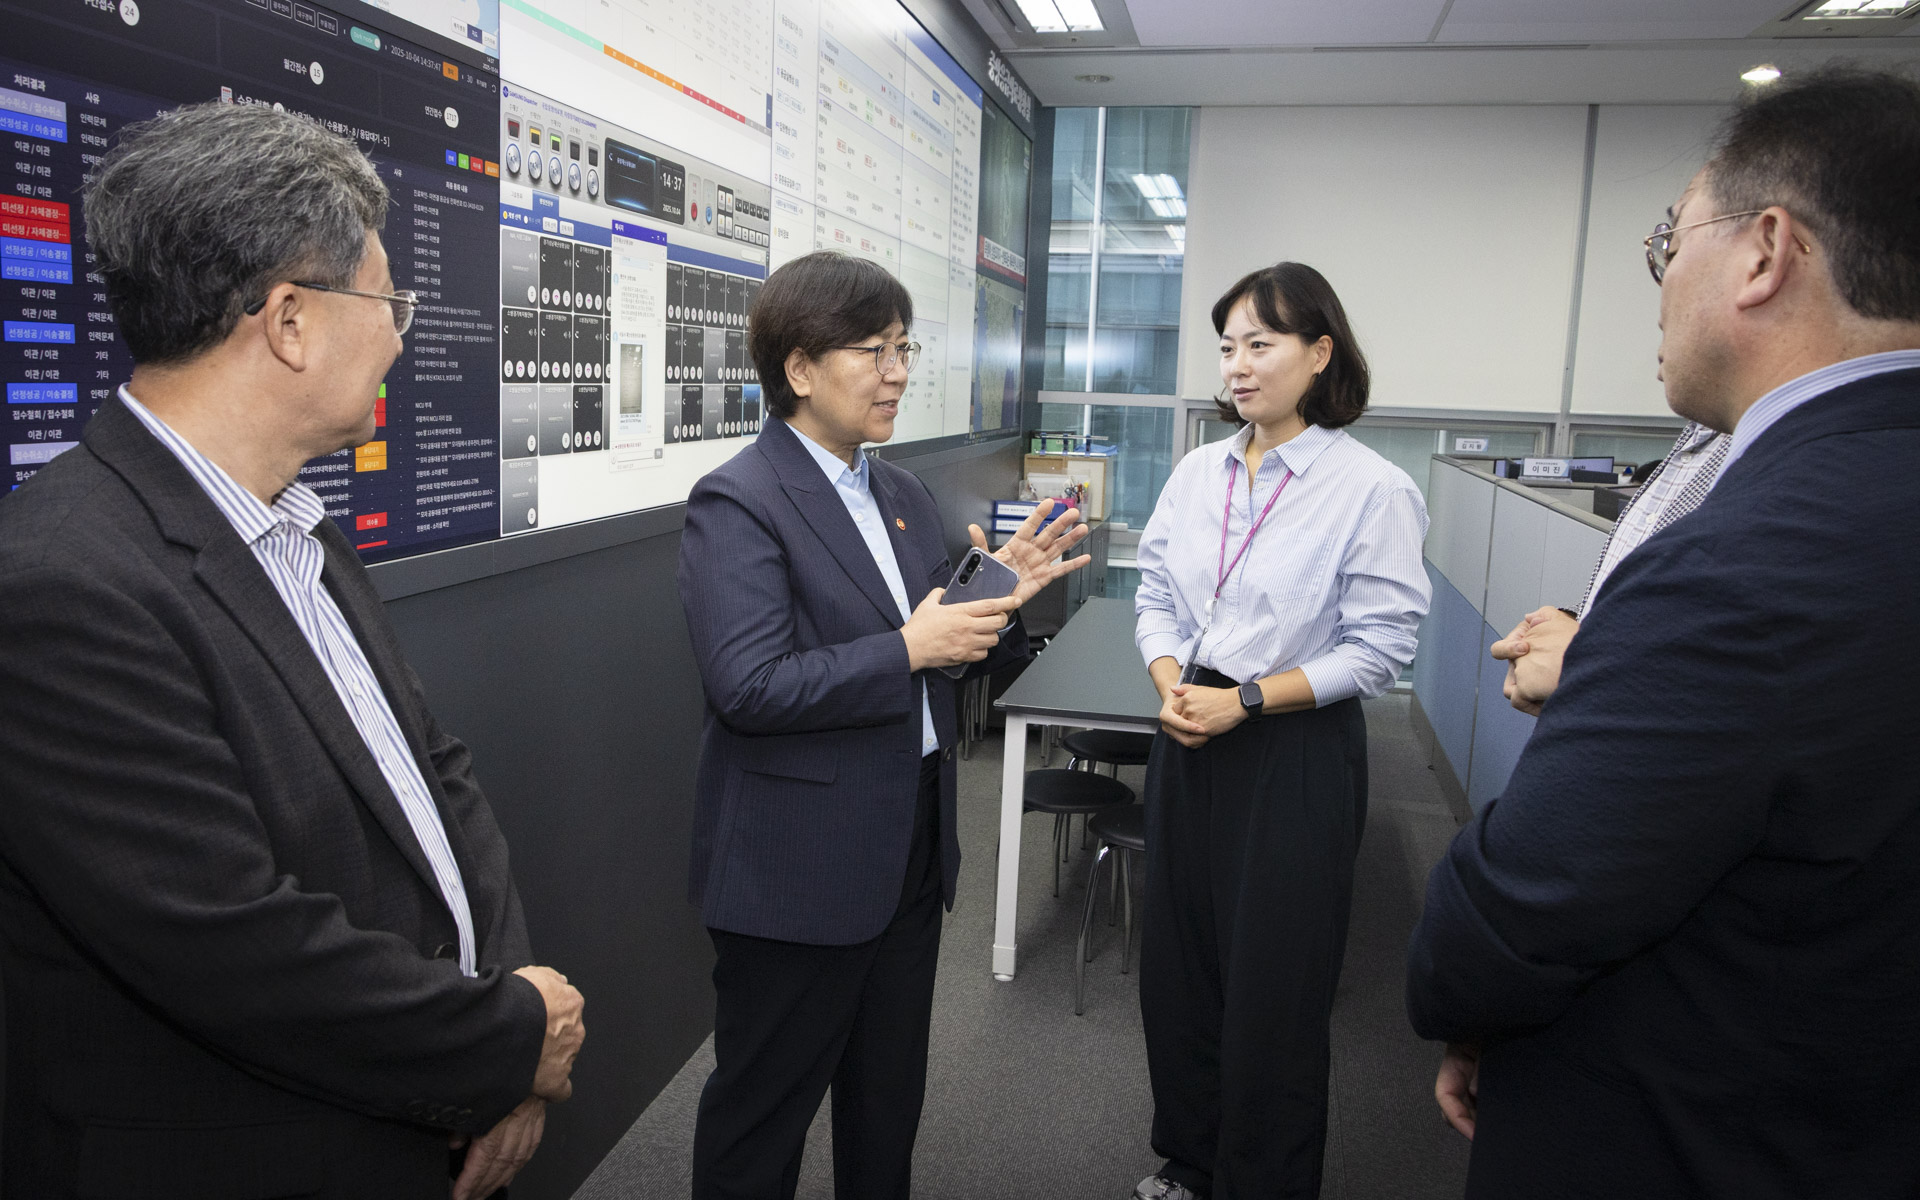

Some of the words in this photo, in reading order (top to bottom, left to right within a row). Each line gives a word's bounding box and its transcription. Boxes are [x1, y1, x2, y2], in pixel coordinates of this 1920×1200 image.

[85, 0, 116, 13] 간접수
[391, 45, 420, 64] 2025-10-04
[420, 57, 441, 72] 14:37:47
[283, 58, 308, 75] 월간접수
[14, 74, 46, 92] 처리결과
[85, 92, 100, 105] 사유
[425, 105, 442, 119] 연간접수
[80, 113, 107, 128] 인력문제
[35, 123, 63, 139] 이송결정
[360, 130, 380, 144] 응답대기
[81, 133, 107, 147] 인력문제
[14, 140, 31, 154] 이관
[35, 143, 51, 157] 이관
[16, 161, 31, 174] 이관
[36, 164, 52, 178] 이관
[16, 183, 32, 195] 이관
[37, 185, 52, 198] 이관
[1, 201, 25, 215] 미선정
[2, 223, 25, 236] 미선정
[5, 244, 34, 257] 선정성공
[40, 247, 68, 260] 이송결정
[6, 265, 35, 278] 선정성공
[41, 268, 69, 281] 이송결정
[21, 287, 36, 298] 이관
[42, 288, 56, 300] 이관
[93, 293, 107, 302] 기타
[22, 308, 37, 319] 이관
[43, 309, 58, 320] 이관
[87, 312, 114, 322] 인력문제
[9, 328, 38, 339] 선정성공
[44, 329, 71, 340] 이송결정
[88, 332, 114, 342] 인력문제
[24, 349, 39, 360] 이관
[44, 349, 59, 360] 이관
[95, 351, 109, 360] 기타
[25, 369, 40, 380] 이관
[45, 369, 60, 380] 이관
[96, 370, 109, 380] 기타
[12, 390, 40, 400] 선정성공
[46, 389, 74, 400] 이송결정
[12, 410, 42, 421] 접수철회
[47, 409, 75, 419] 접수철회
[27, 429, 42, 440] 이관
[48, 428, 62, 439] 이관
